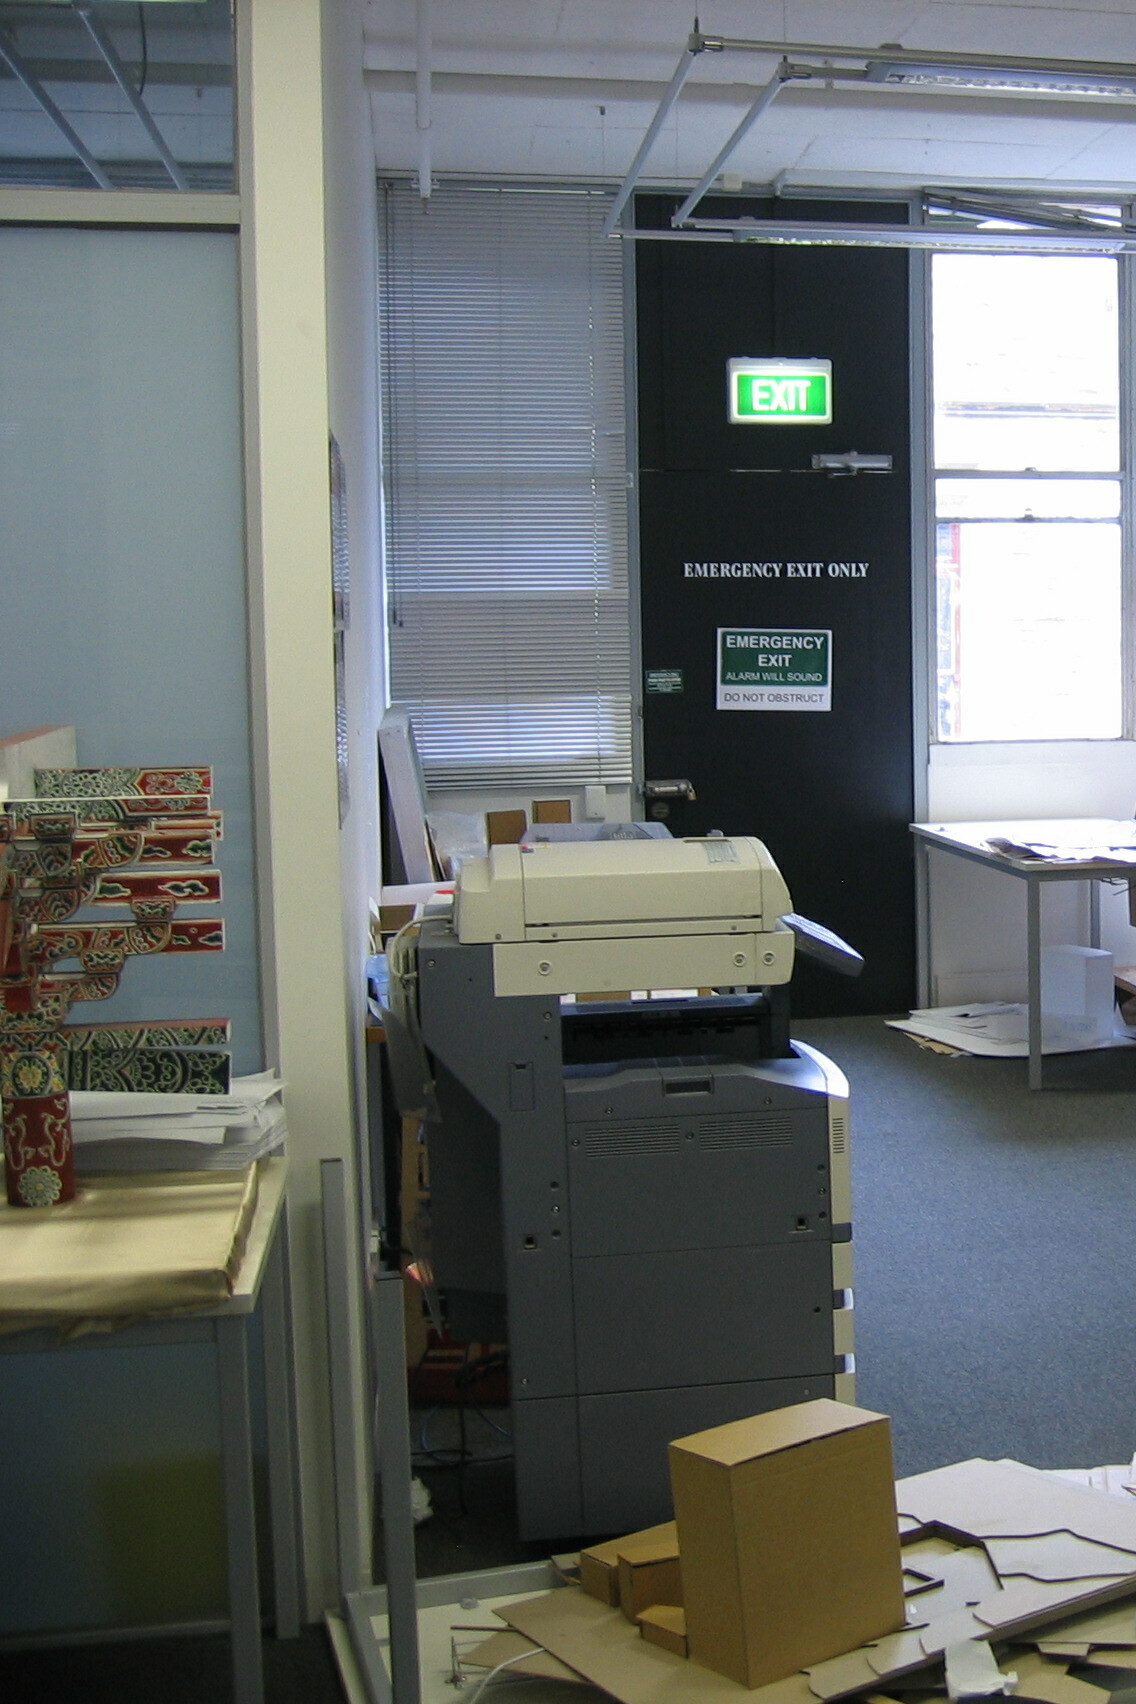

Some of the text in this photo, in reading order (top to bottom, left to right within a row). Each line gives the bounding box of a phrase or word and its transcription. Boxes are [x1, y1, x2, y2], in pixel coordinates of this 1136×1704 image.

[752, 379, 811, 411] EXIT
[683, 562, 869, 578] EMERGENCY EXIT ONLY
[726, 635, 824, 649] EMERGENCY
[758, 654, 792, 667] EXIT
[725, 672, 823, 682] ALARM WILL SOUND
[724, 692, 824, 703] DO NOT OBSTRUCT
